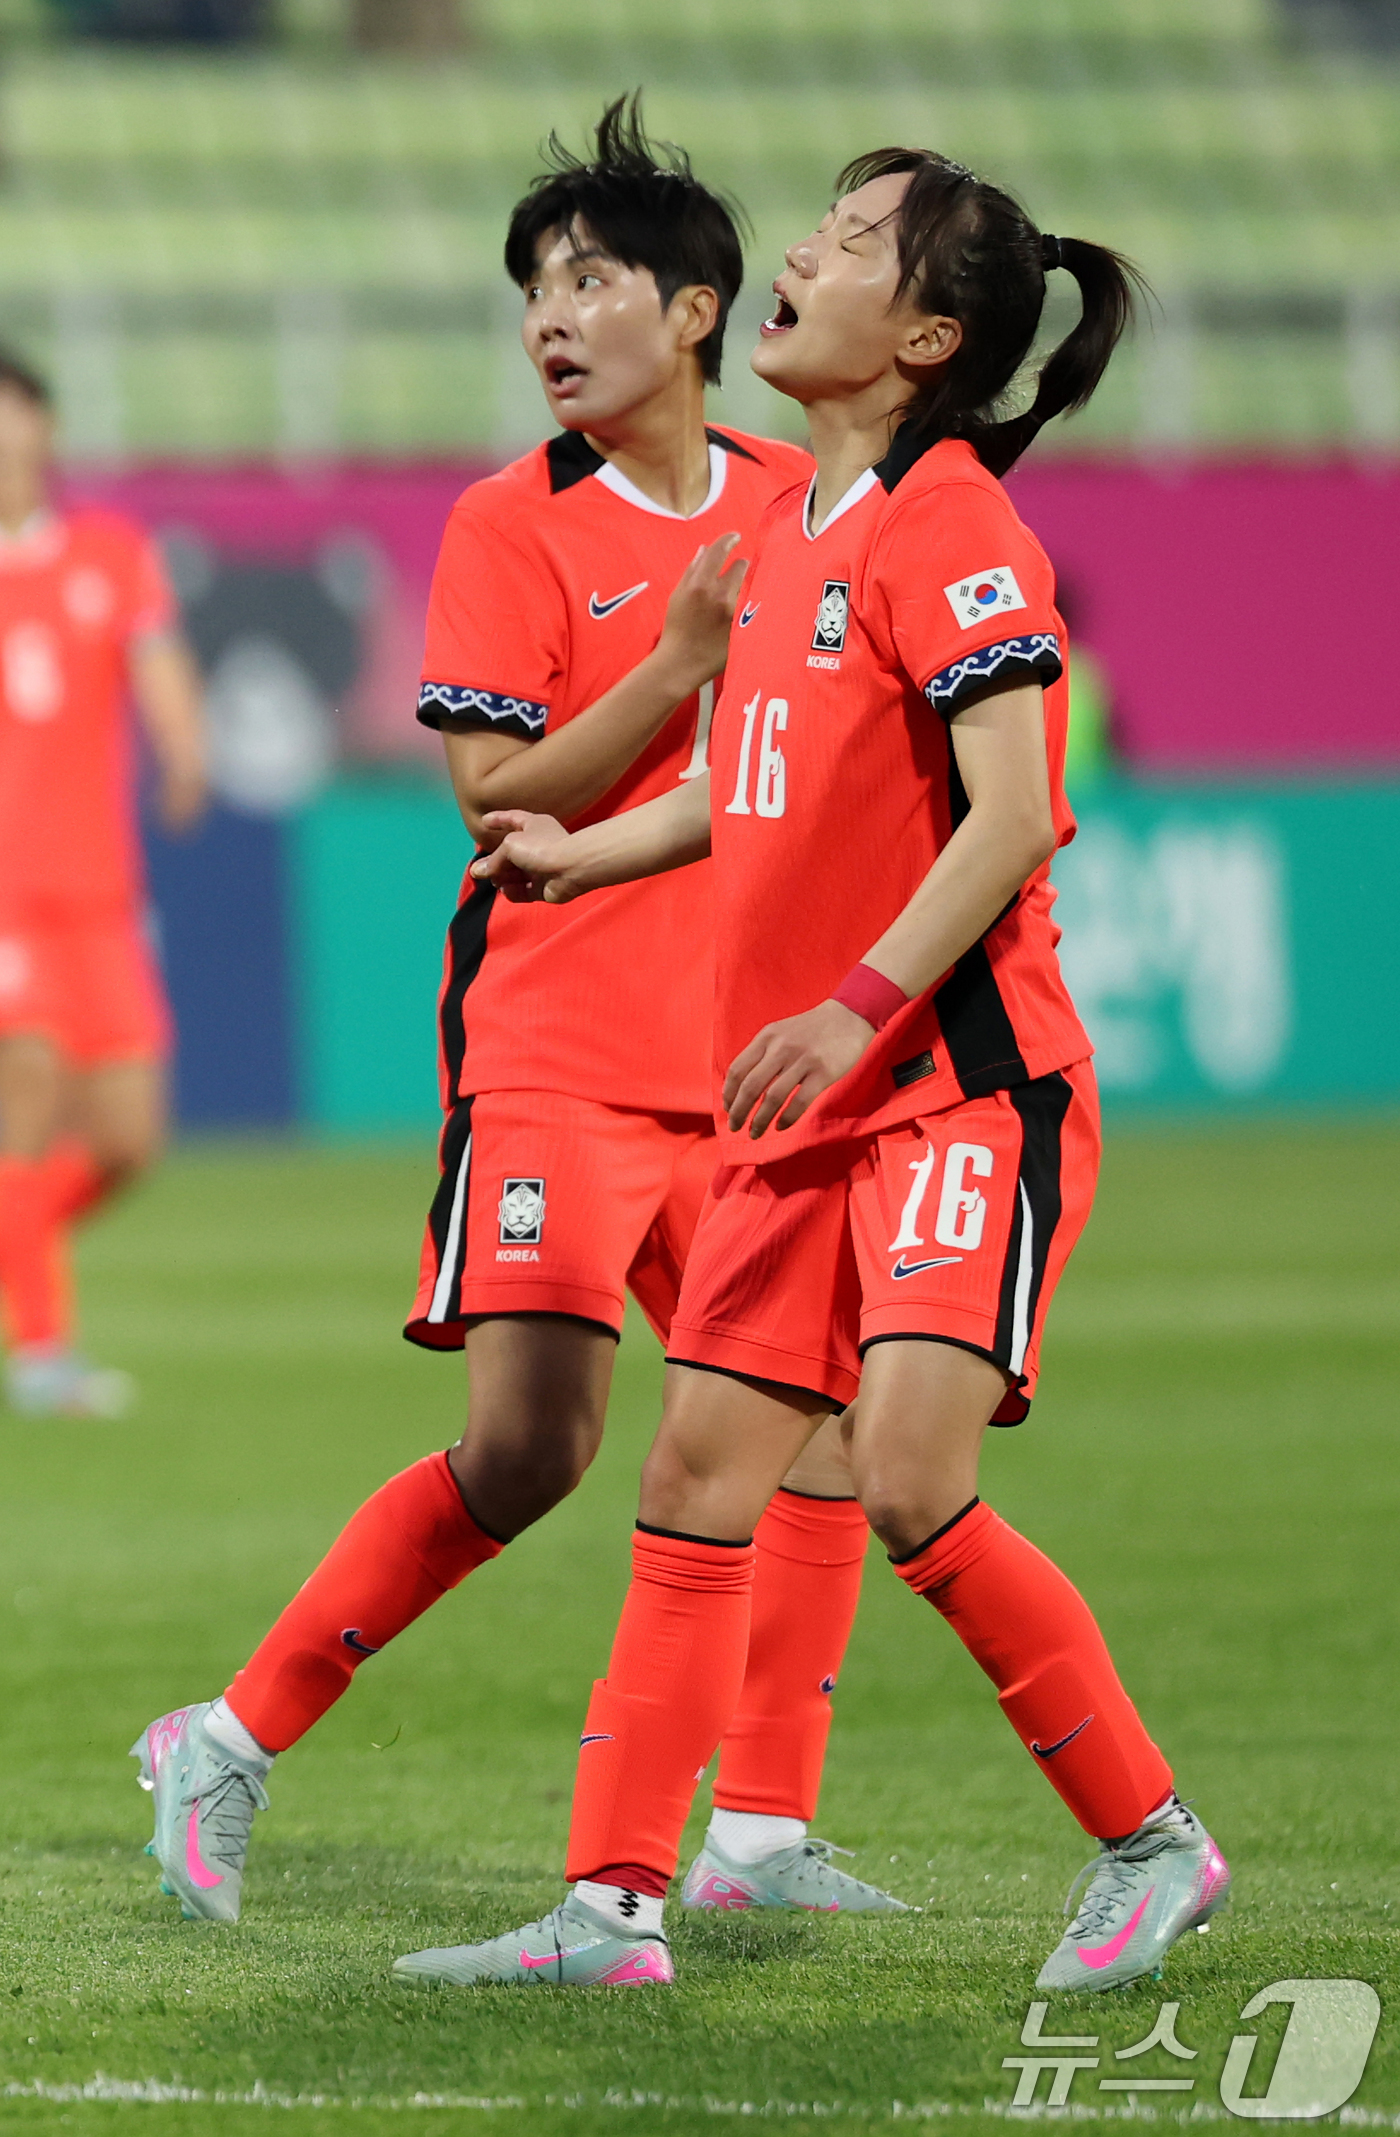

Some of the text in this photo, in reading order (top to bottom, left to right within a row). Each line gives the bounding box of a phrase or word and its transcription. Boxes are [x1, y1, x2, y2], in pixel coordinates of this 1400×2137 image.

[806, 654, 841, 670] KOREA
[725, 688, 789, 819] 16
[888, 1141, 994, 1252] 16
[495, 1249, 540, 1263] KOREA
